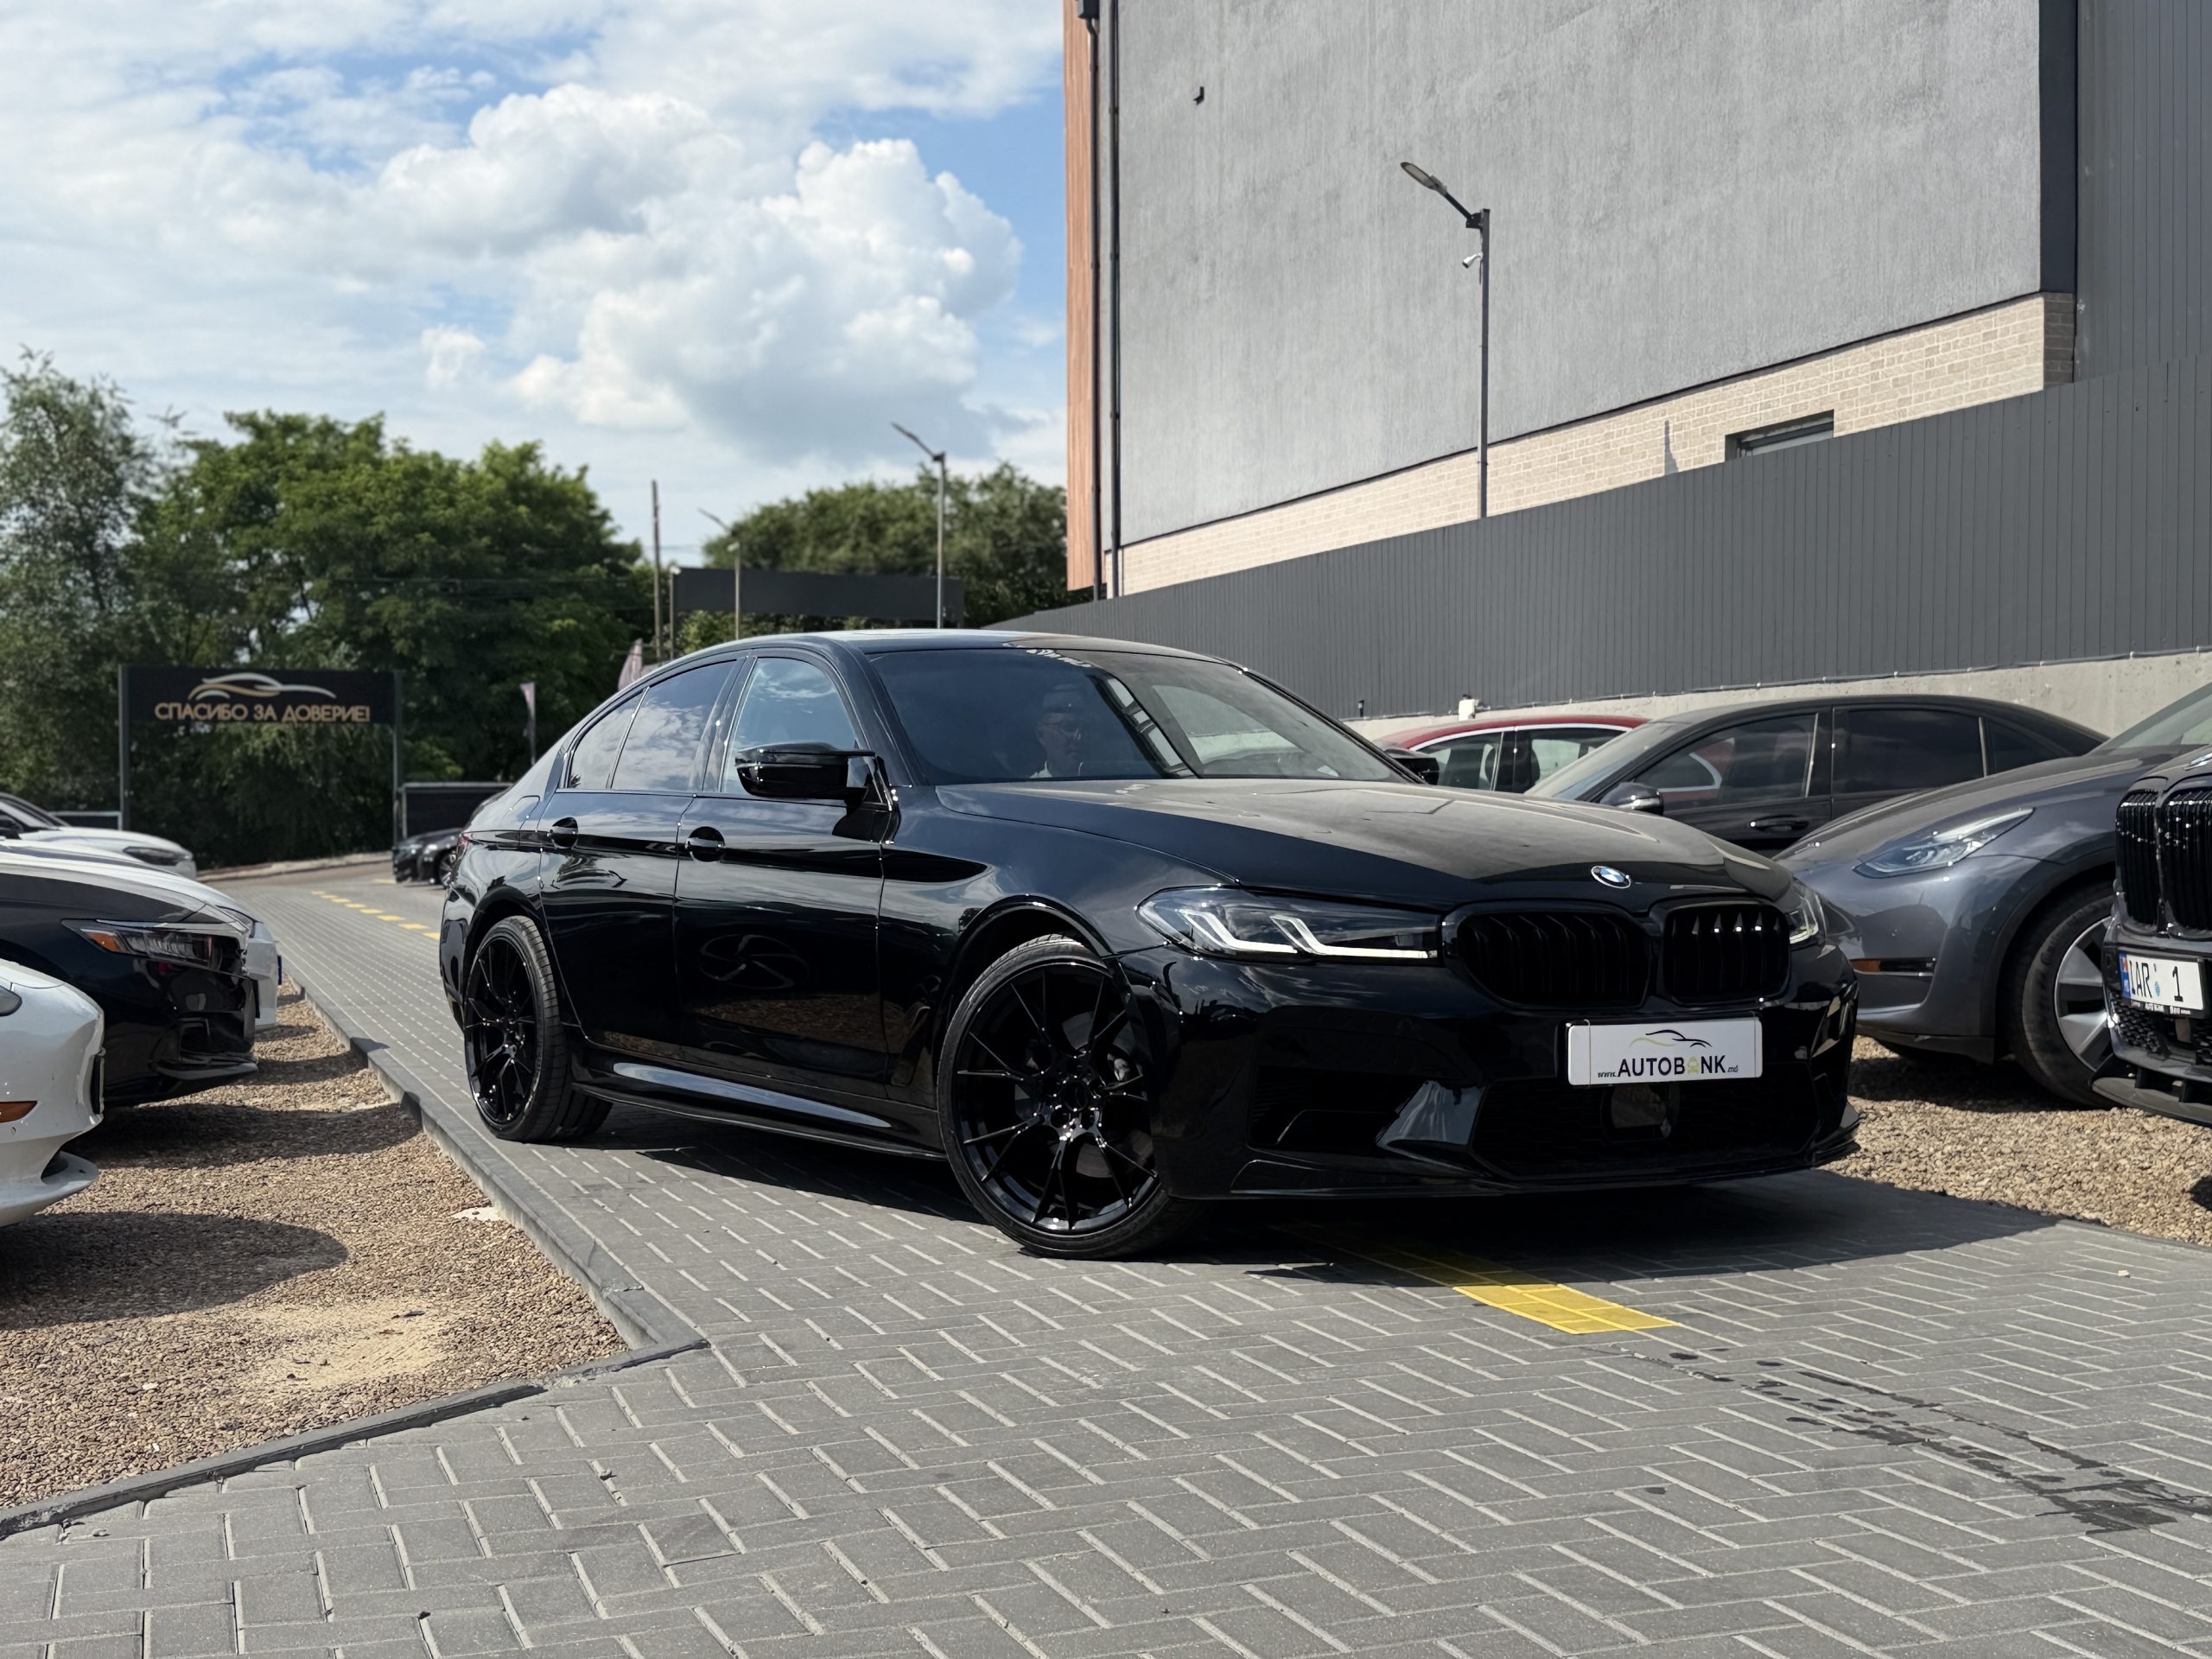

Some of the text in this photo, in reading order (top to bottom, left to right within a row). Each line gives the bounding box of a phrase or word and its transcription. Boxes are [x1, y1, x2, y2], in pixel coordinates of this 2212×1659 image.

[154, 702, 371, 723] СПАСИБО ЗА ДОВЕРИЕ!
[2172, 966, 2183, 1002] 1
